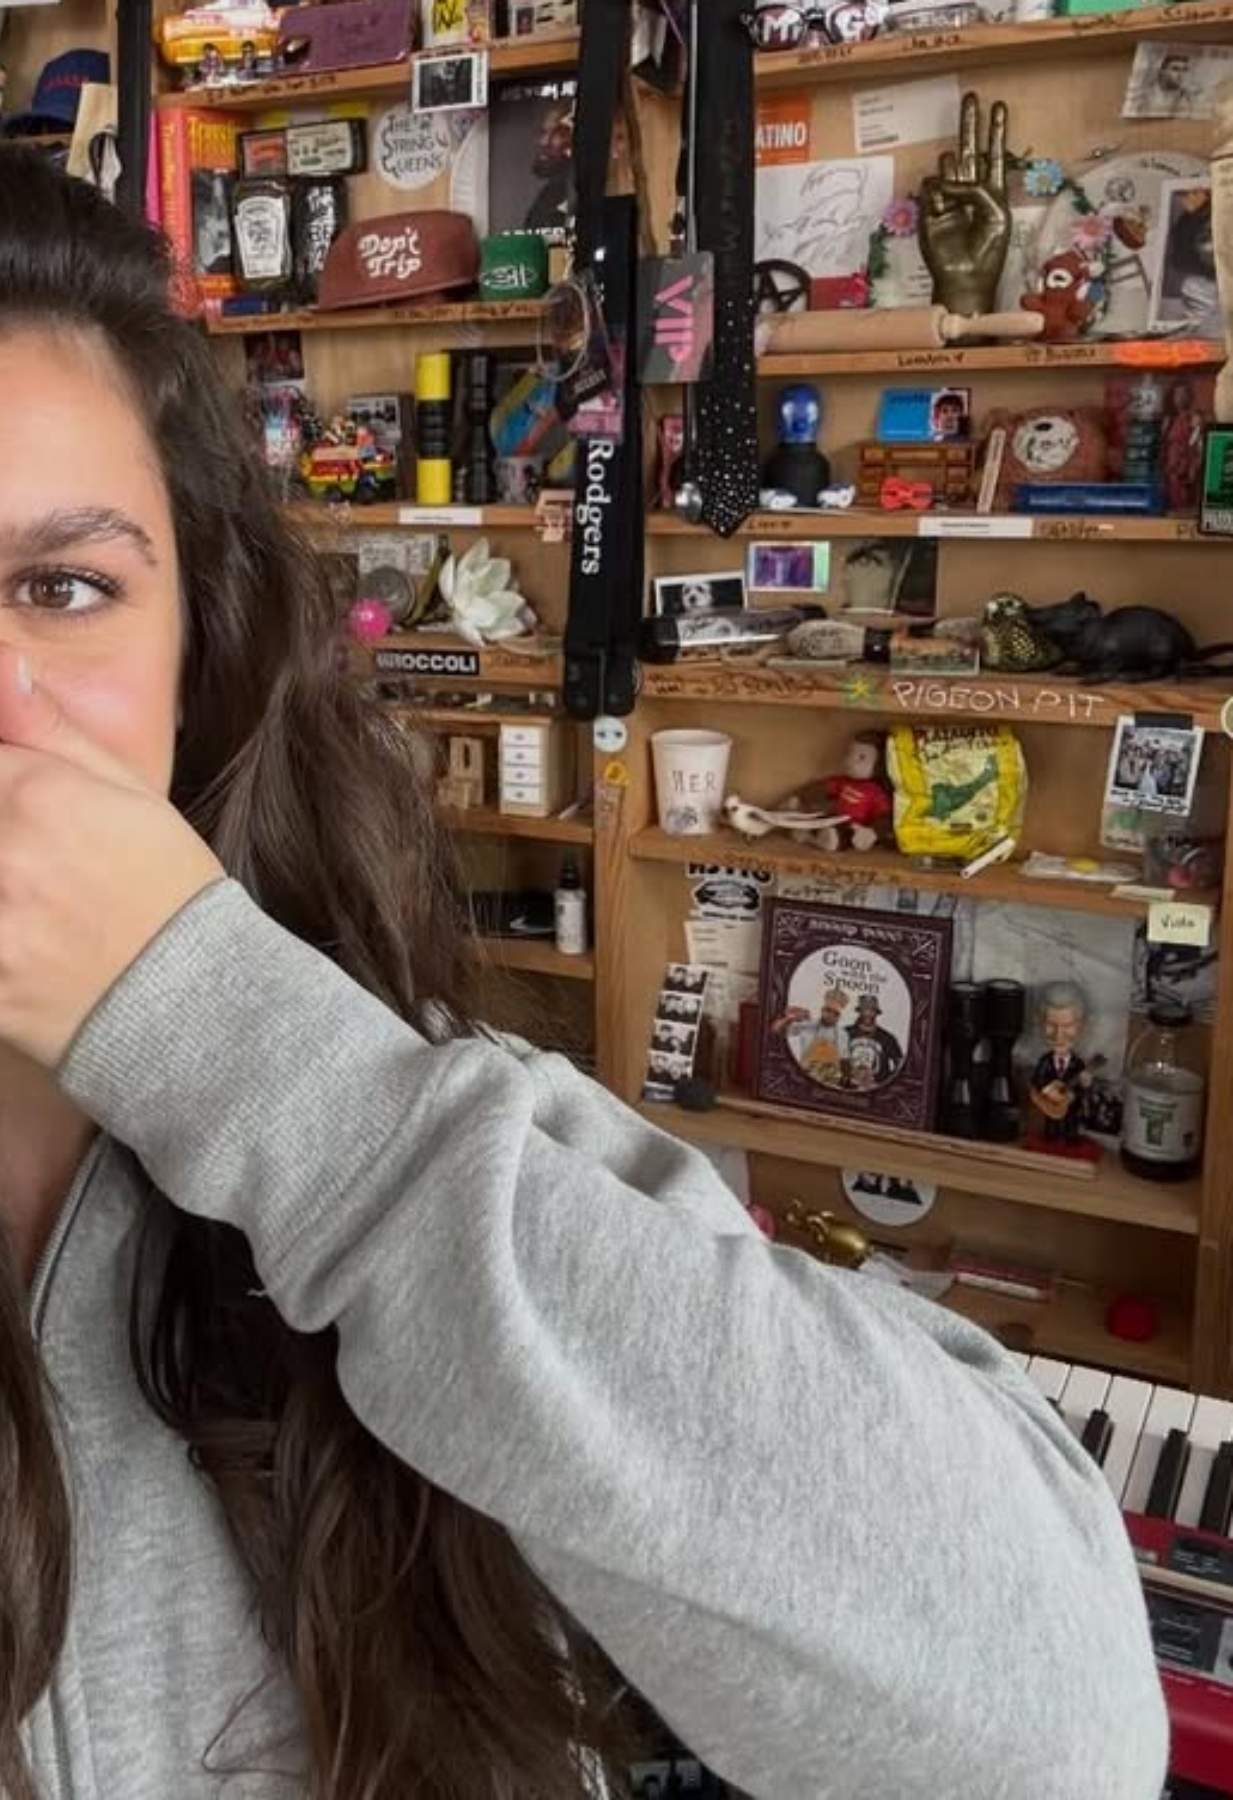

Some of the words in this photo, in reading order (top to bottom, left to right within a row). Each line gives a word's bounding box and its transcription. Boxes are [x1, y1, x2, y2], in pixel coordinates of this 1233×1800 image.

[756, 122, 807, 148] ATINO
[358, 226, 420, 259] Don't
[366, 254, 423, 280] Trip
[654, 275, 694, 362] VIP
[575, 439, 615, 575] Rodgers
[892, 681, 1020, 713] PIGEON
[1033, 689, 1106, 719] PIT
[823, 950, 873, 972] Goon
[823, 969, 879, 994] Spoon
